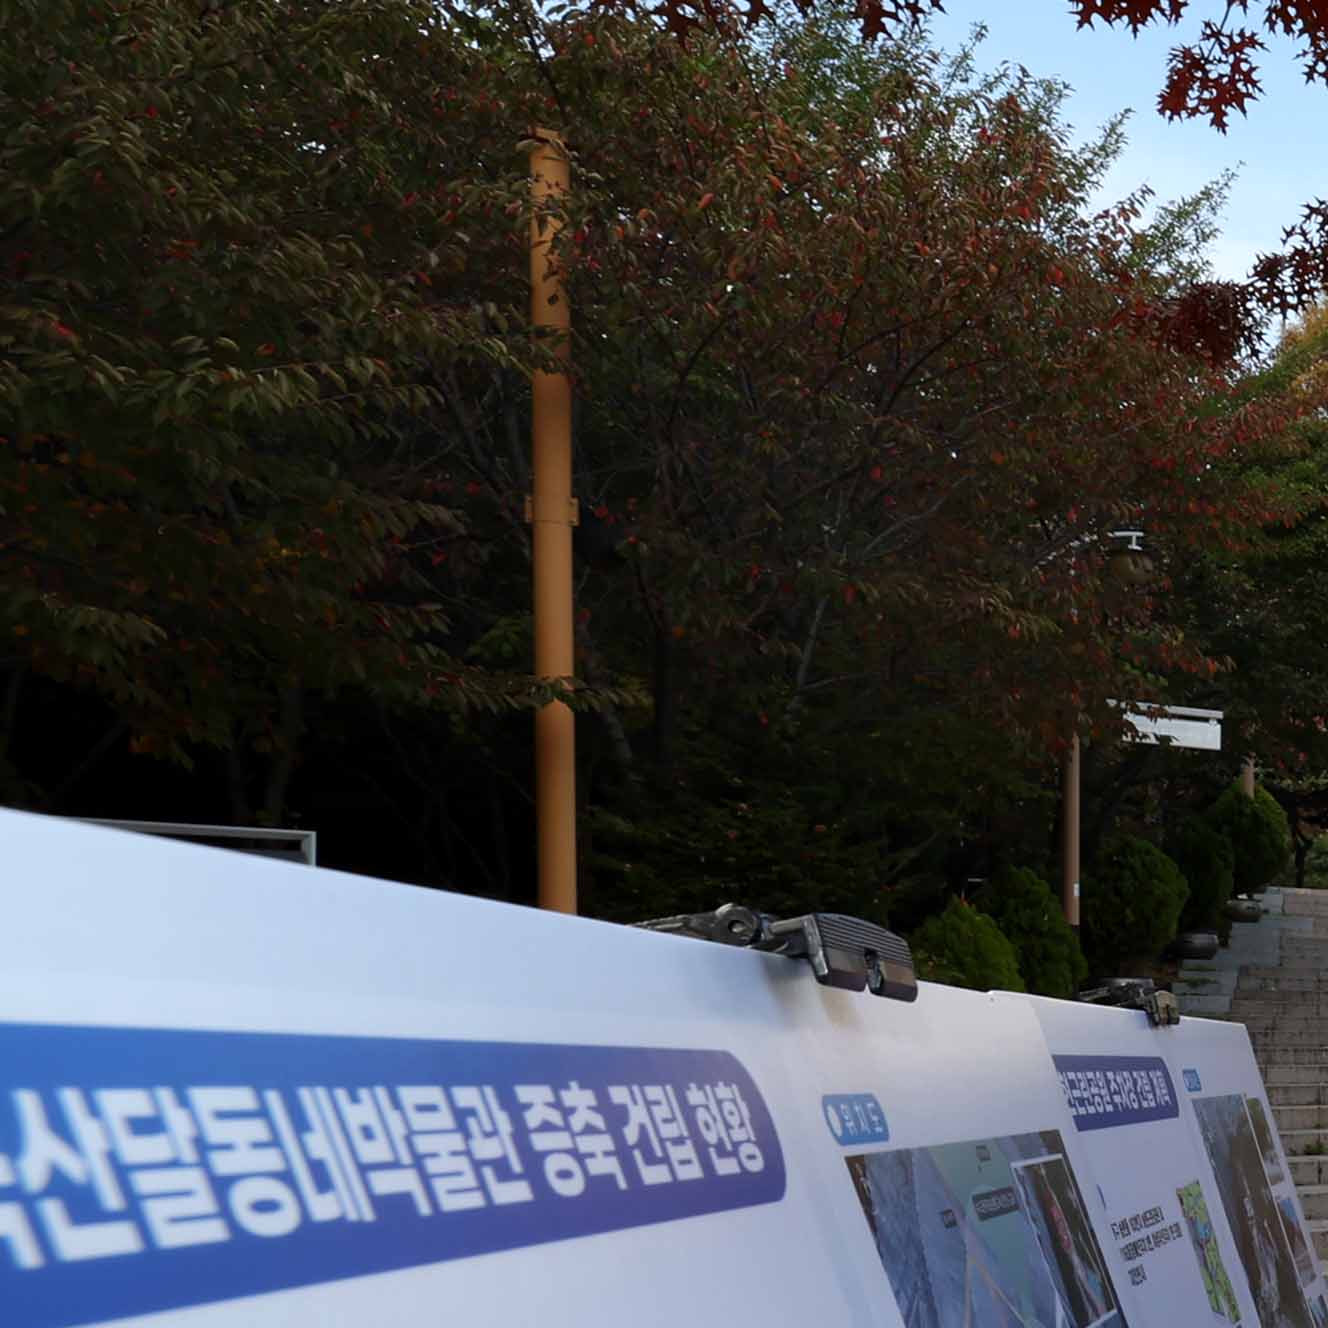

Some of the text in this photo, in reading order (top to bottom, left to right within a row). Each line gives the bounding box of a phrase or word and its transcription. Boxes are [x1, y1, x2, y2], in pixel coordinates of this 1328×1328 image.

[1106, 1071, 1140, 1112] 주차장
[1133, 1070, 1157, 1108] 건립
[514, 1079, 628, 1198] 증축
[607, 1083, 705, 1187] 건립
[686, 1079, 766, 1177] 현황
